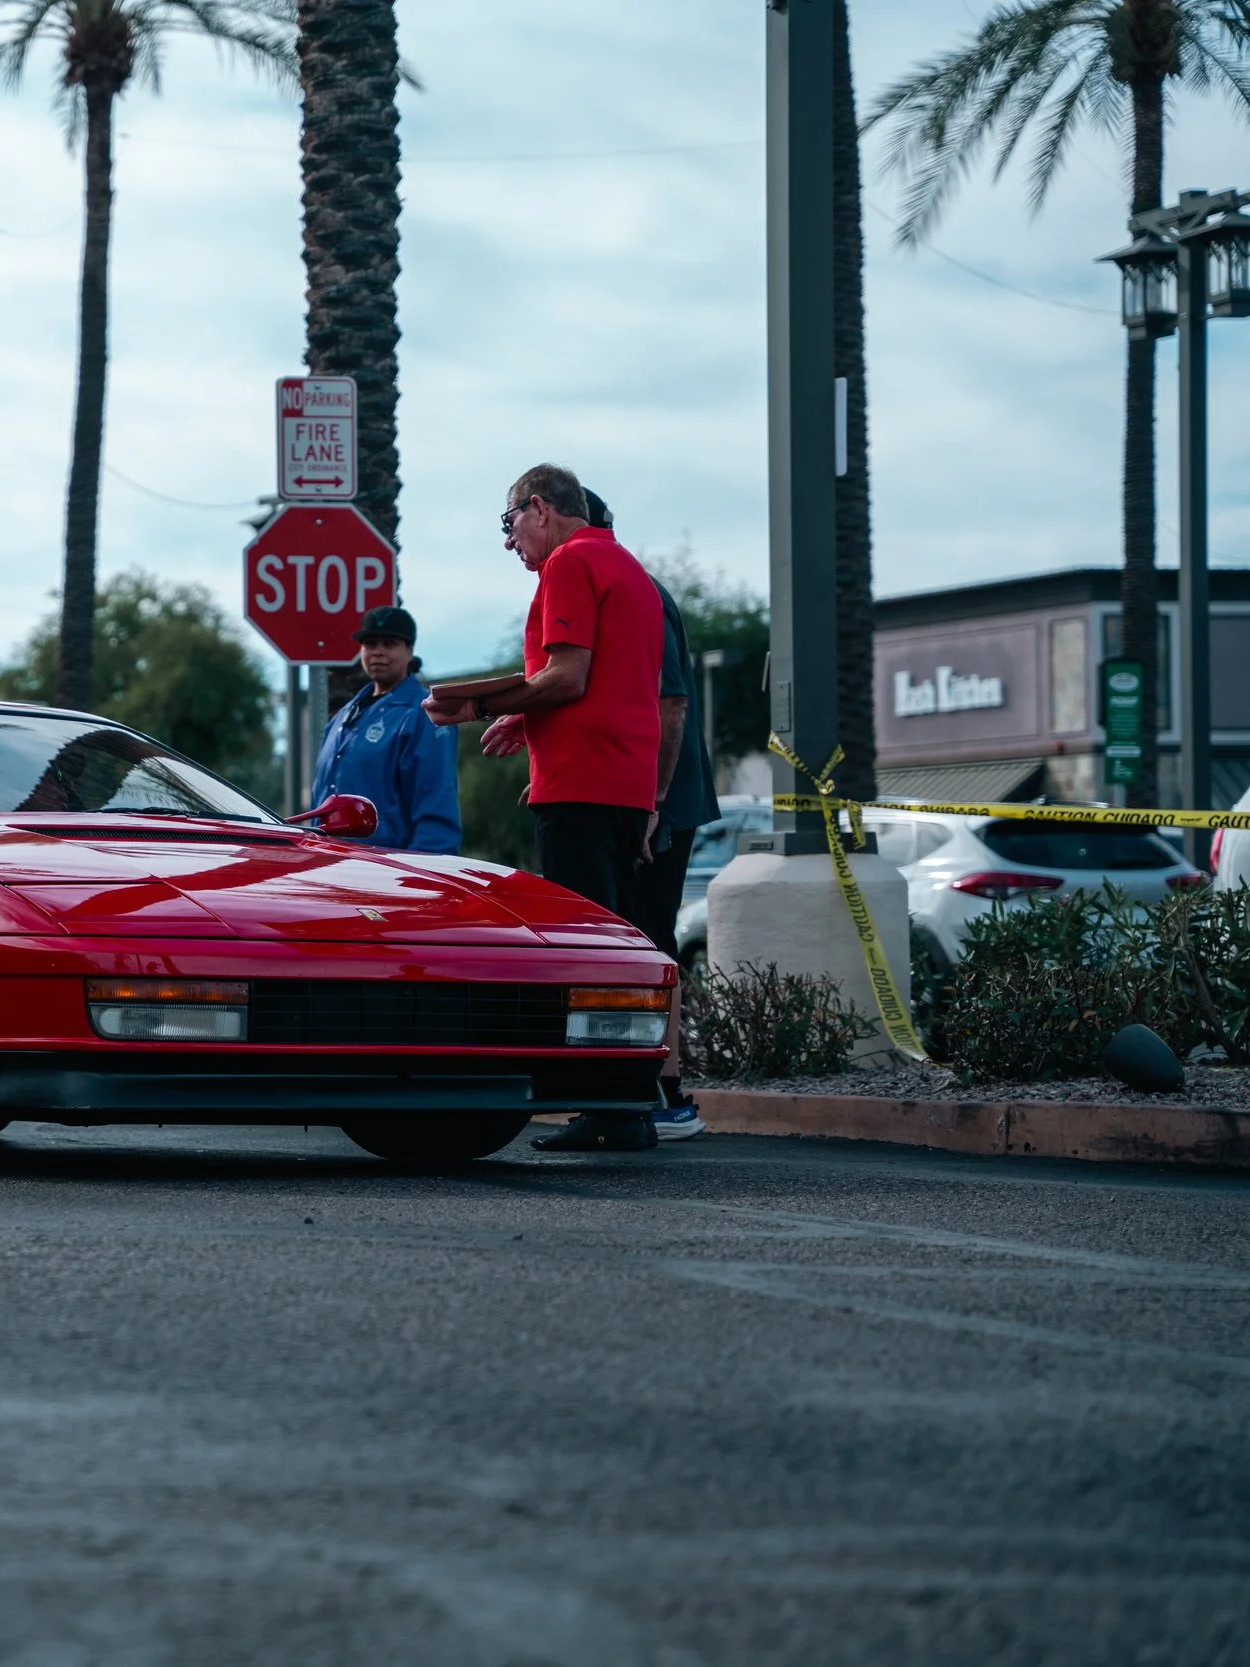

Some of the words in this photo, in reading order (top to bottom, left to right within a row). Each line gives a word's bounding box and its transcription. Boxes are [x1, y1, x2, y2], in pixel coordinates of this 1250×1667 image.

[282, 387, 302, 409] NO
[303, 392, 350, 407] PARKING
[295, 423, 340, 442] FIRE
[291, 443, 345, 462] LANE
[255, 554, 386, 613] STOP
[1024, 809, 1097, 823] CAUTION
[1103, 811, 1175, 826] CUIDADO
[1208, 815, 1250, 829] CAUT
